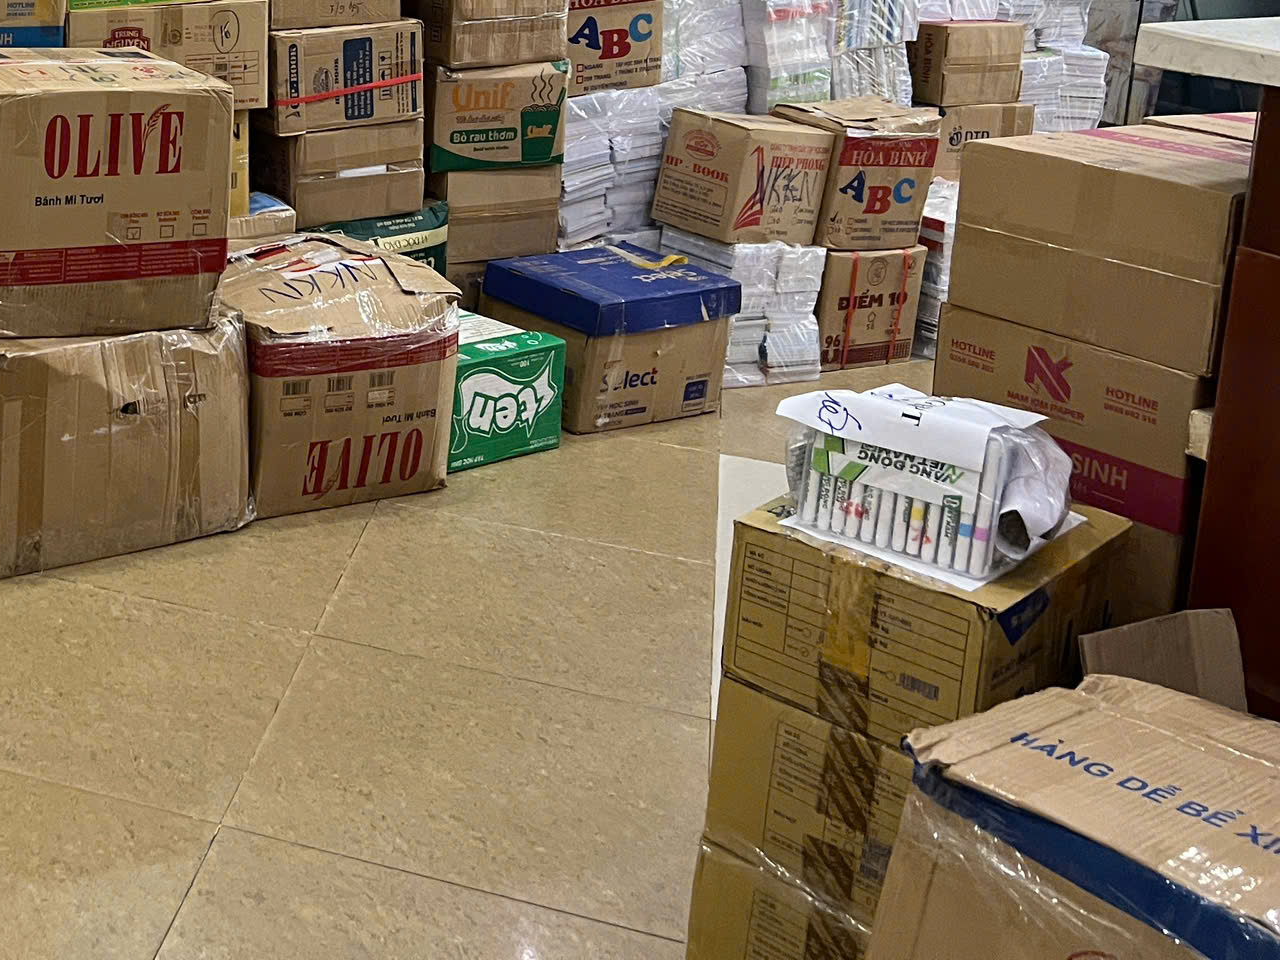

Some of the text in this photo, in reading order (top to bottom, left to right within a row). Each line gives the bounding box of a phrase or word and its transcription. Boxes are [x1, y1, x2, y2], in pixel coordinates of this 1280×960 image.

[7, 2, 35, 10] HOTLINE
[568, 13, 653, 60] ABC
[451, 81, 515, 113] Unif
[43, 105, 185, 180] OLIVE
[453, 129, 515, 143] Bò rau thơm
[852, 147, 928, 166] HÒA BÌNH
[692, 162, 729, 184] BOOK
[35, 193, 104, 208] Bánh Tươi
[839, 170, 916, 214] ABC
[951, 338, 996, 360] HOTLINE
[469, 386, 539, 432] ten
[1007, 390, 1029, 405] NAM
[1049, 403, 1085, 422] PAPER
[1106, 386, 1159, 411] HOTLINE
[302, 428, 424, 498] OLIVE
[1071, 452, 1128, 491] SINH
[1009, 730, 1246, 828] HÀNG DỄ BỂ
